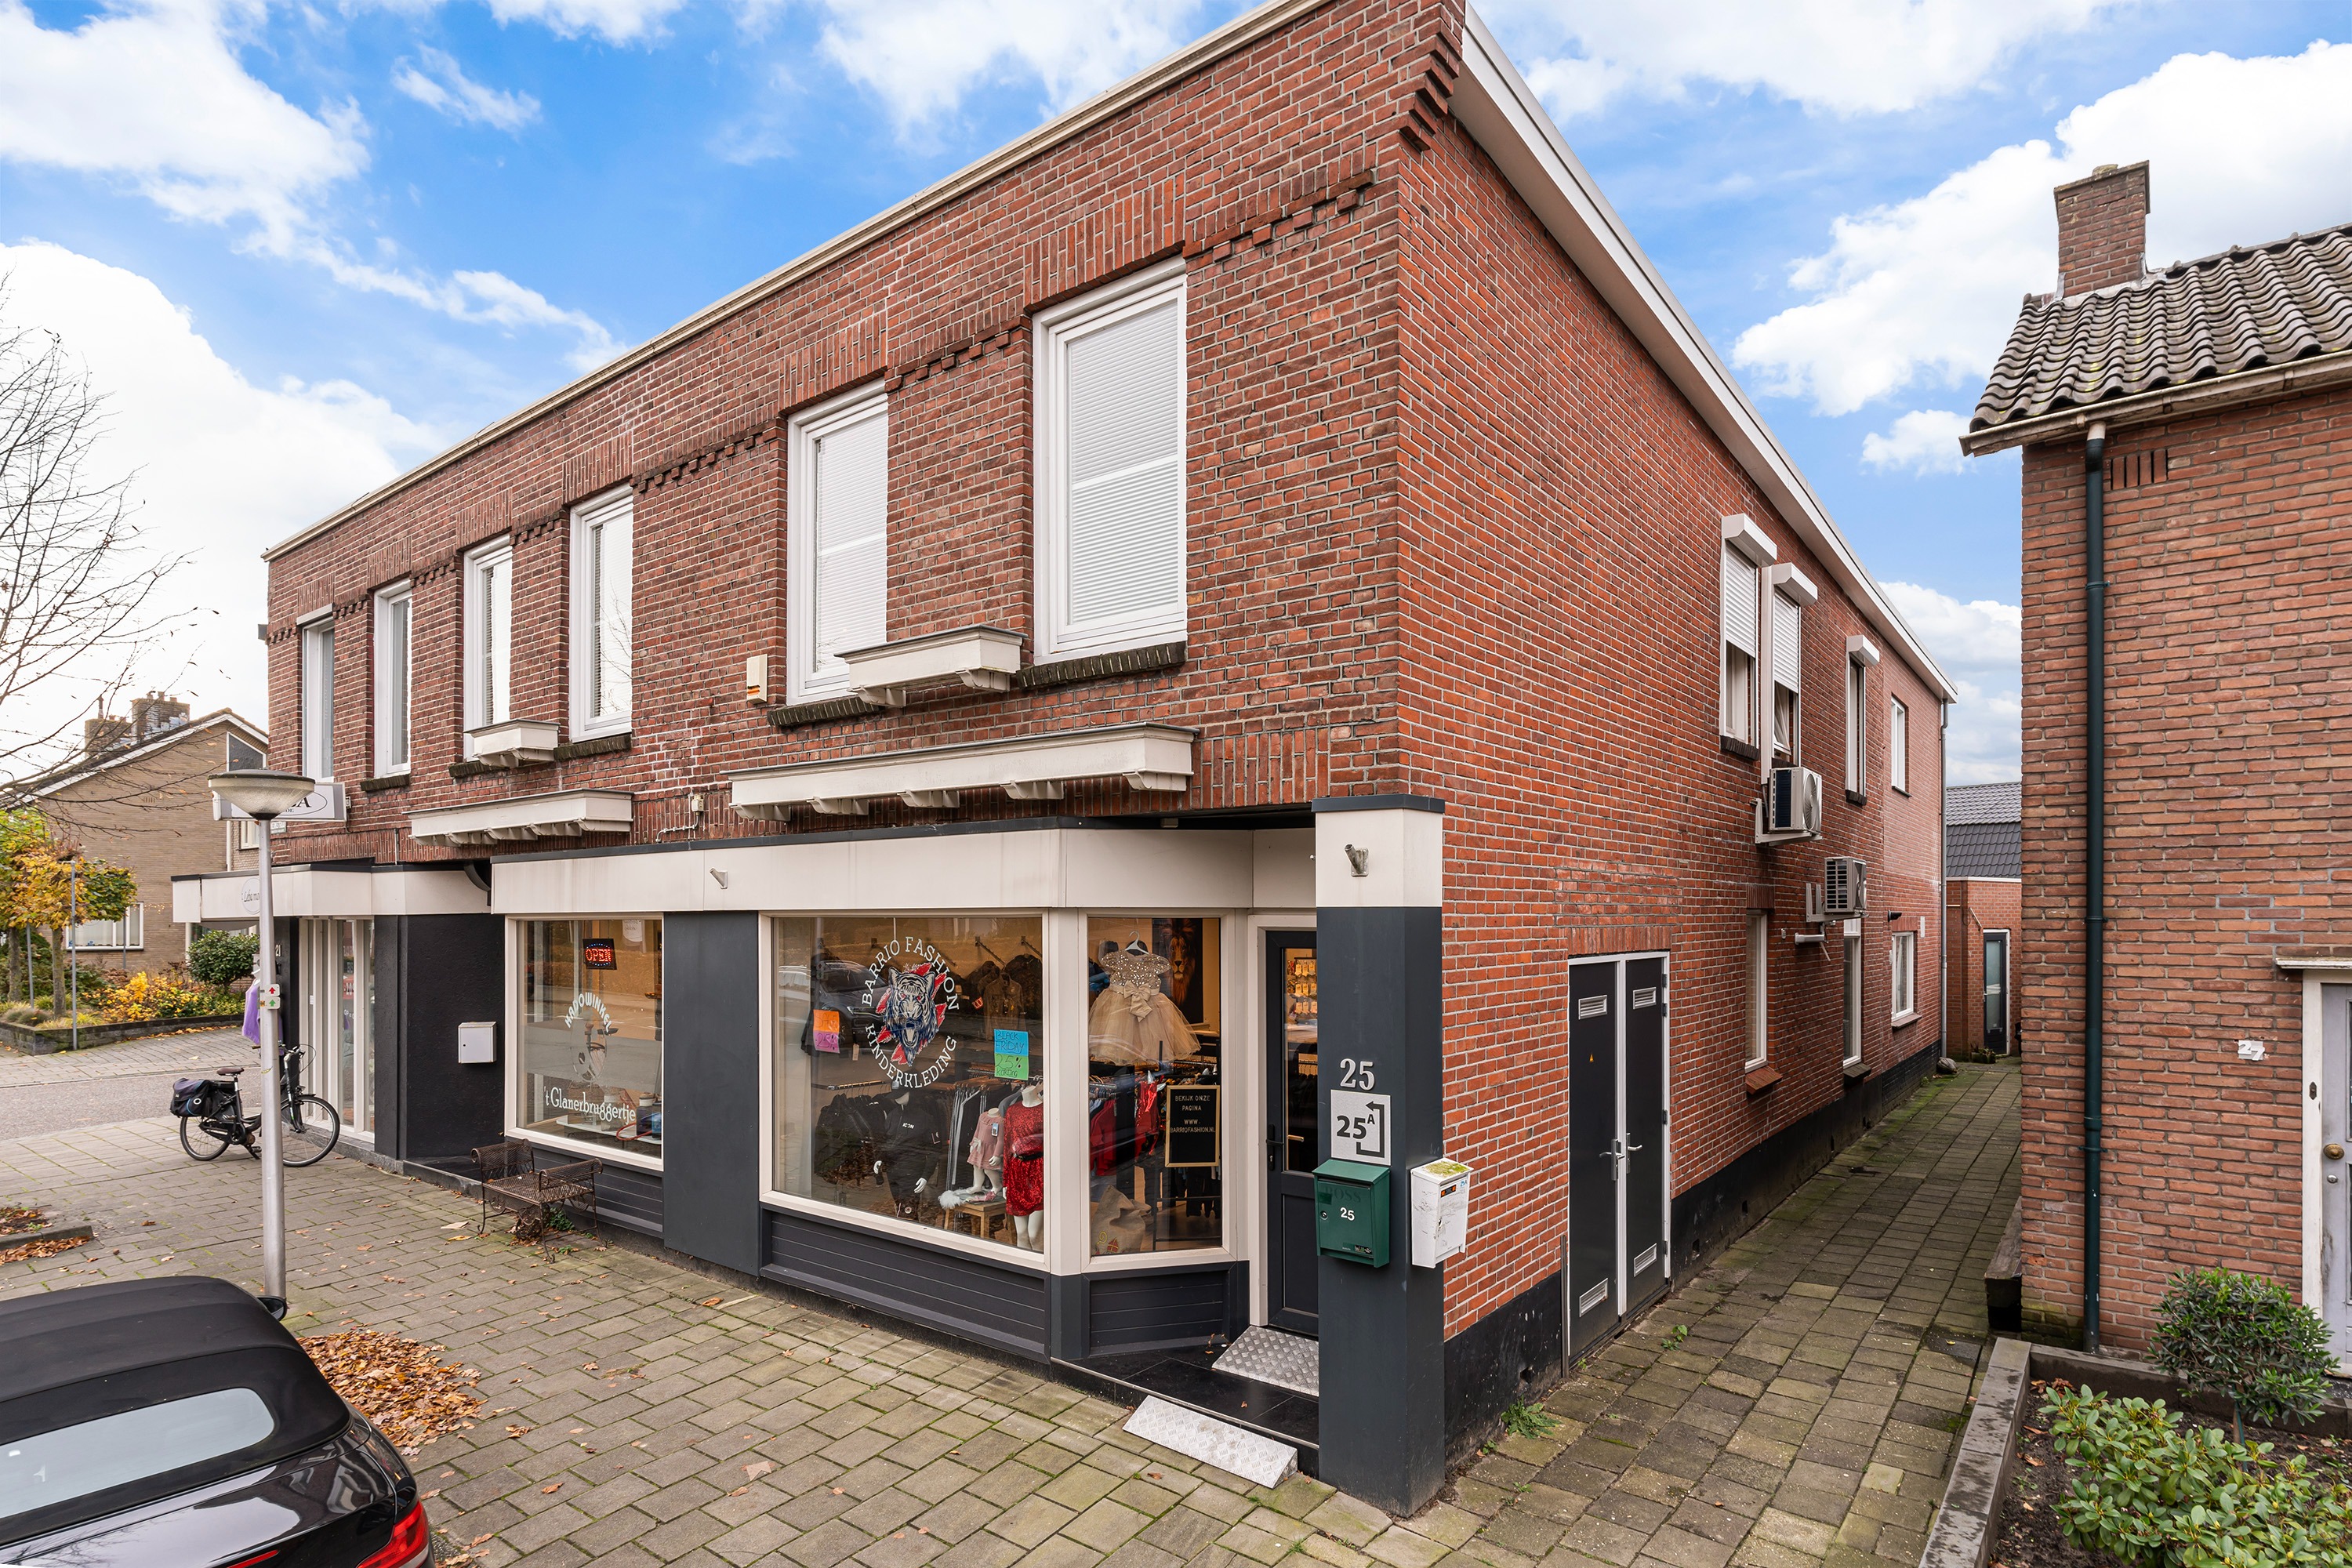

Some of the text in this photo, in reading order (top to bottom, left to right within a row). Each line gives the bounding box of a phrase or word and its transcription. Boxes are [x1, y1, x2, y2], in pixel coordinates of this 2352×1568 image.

[275, 944, 281, 957] 21
[585, 949, 612, 962] OPEN
[862, 936, 959, 1011] BARRIO FASHION
[564, 992, 612, 1033] KADOWINKEL
[865, 1023, 957, 1088] KINDERKLEDING
[995, 1054, 1022, 1069] 25%
[2238, 1040, 2266, 1061] 27
[1340, 1058, 1375, 1091] 25
[550, 1087, 636, 1125] Glanerbruggertje
[1340, 1207, 1355, 1221] 25
